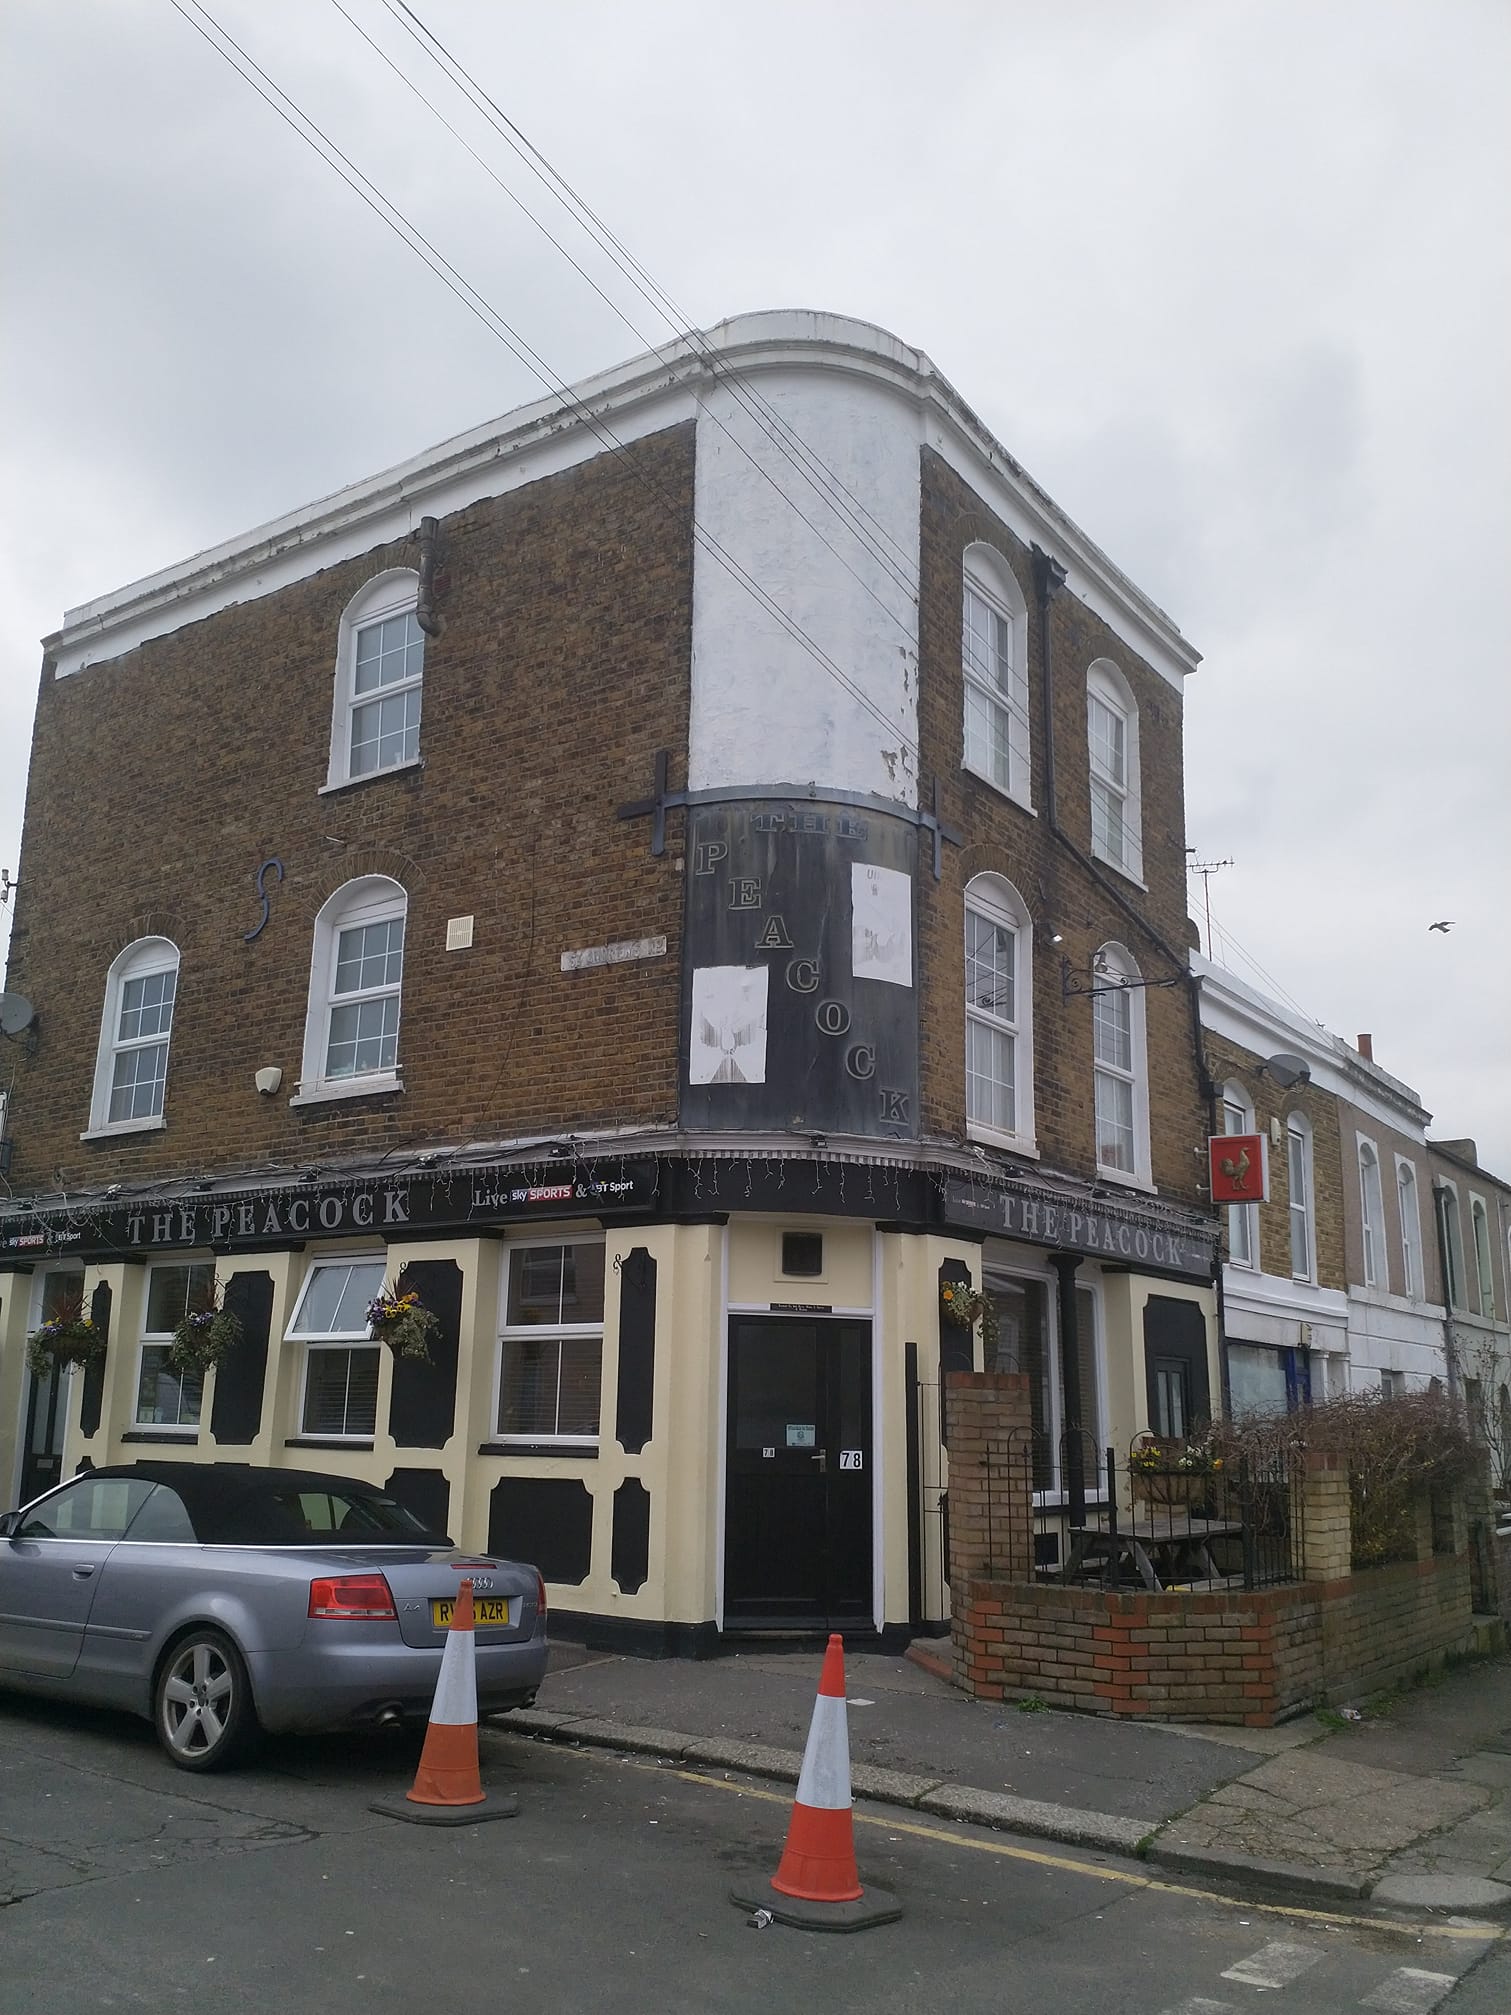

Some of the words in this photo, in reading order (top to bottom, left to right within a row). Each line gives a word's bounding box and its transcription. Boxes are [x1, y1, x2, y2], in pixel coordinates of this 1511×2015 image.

[750, 811, 868, 840] THE
[695, 842, 909, 1126] PEACOCK
[473, 1189, 508, 1208] Live
[512, 1190, 527, 1202] sky
[530, 1187, 571, 1200] SPORTS
[575, 1184, 588, 1198] &
[609, 1181, 634, 1193] Sport
[128, 1210, 195, 1244] THE
[214, 1190, 409, 1238] PEACOCK
[1000, 1197, 1059, 1238] THE
[1070, 1212, 1183, 1265] PEACOCK
[842, 1452, 861, 1468] 78
[480, 1602, 504, 1620] AZR
